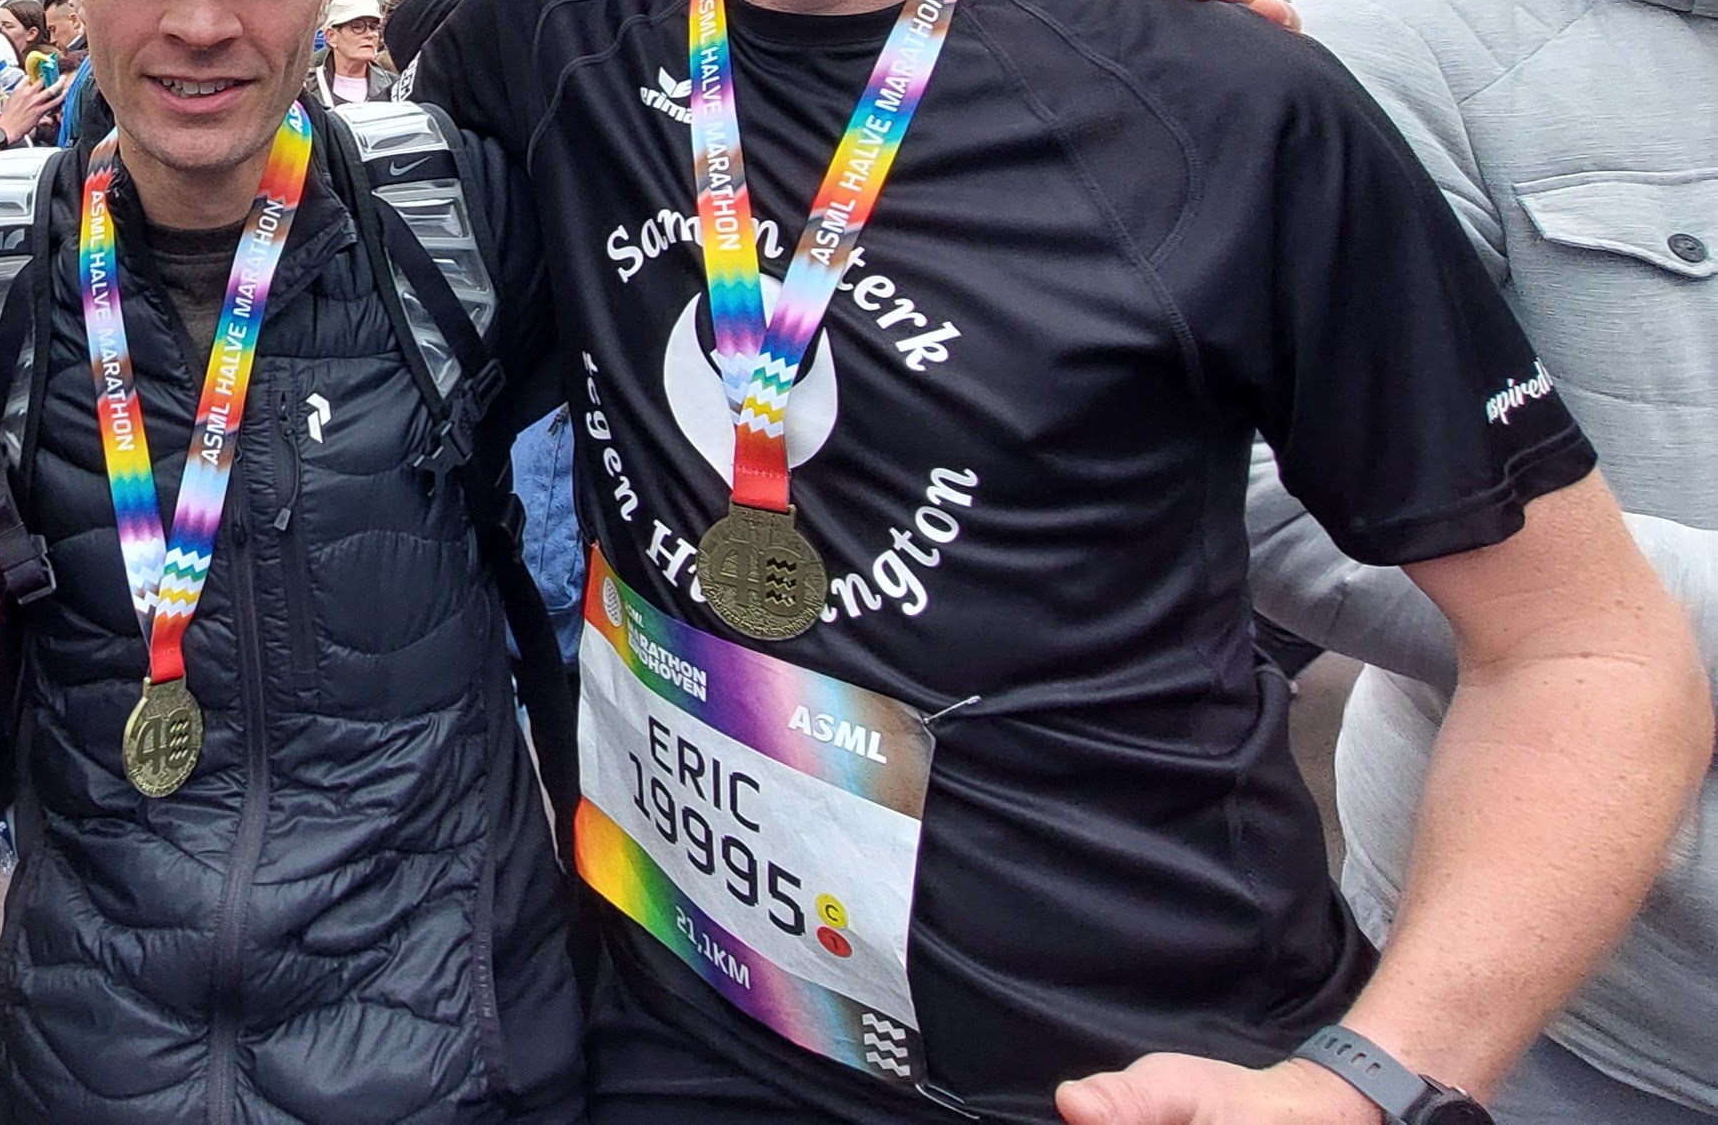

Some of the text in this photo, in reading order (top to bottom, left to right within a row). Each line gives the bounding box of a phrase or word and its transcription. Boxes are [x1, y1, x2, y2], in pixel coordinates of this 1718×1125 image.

[640, 86, 692, 125] erima
[699, 44, 723, 117] HALVE
[702, 121, 742, 252] MARATHON
[810, 198, 857, 267] ASML
[838, 114, 892, 193] HALVE
[606, 209, 784, 284] Samn
[89, 190, 136, 452] ASML HALVE MARATHON
[201, 199, 285, 466] ASML HALVE MARATHON
[648, 714, 761, 834] ERIC
[788, 704, 888, 765] ASML
[628, 750, 807, 937] 19995
[675, 906, 751, 991] 21,1KM
[825, 903, 840, 922] C
